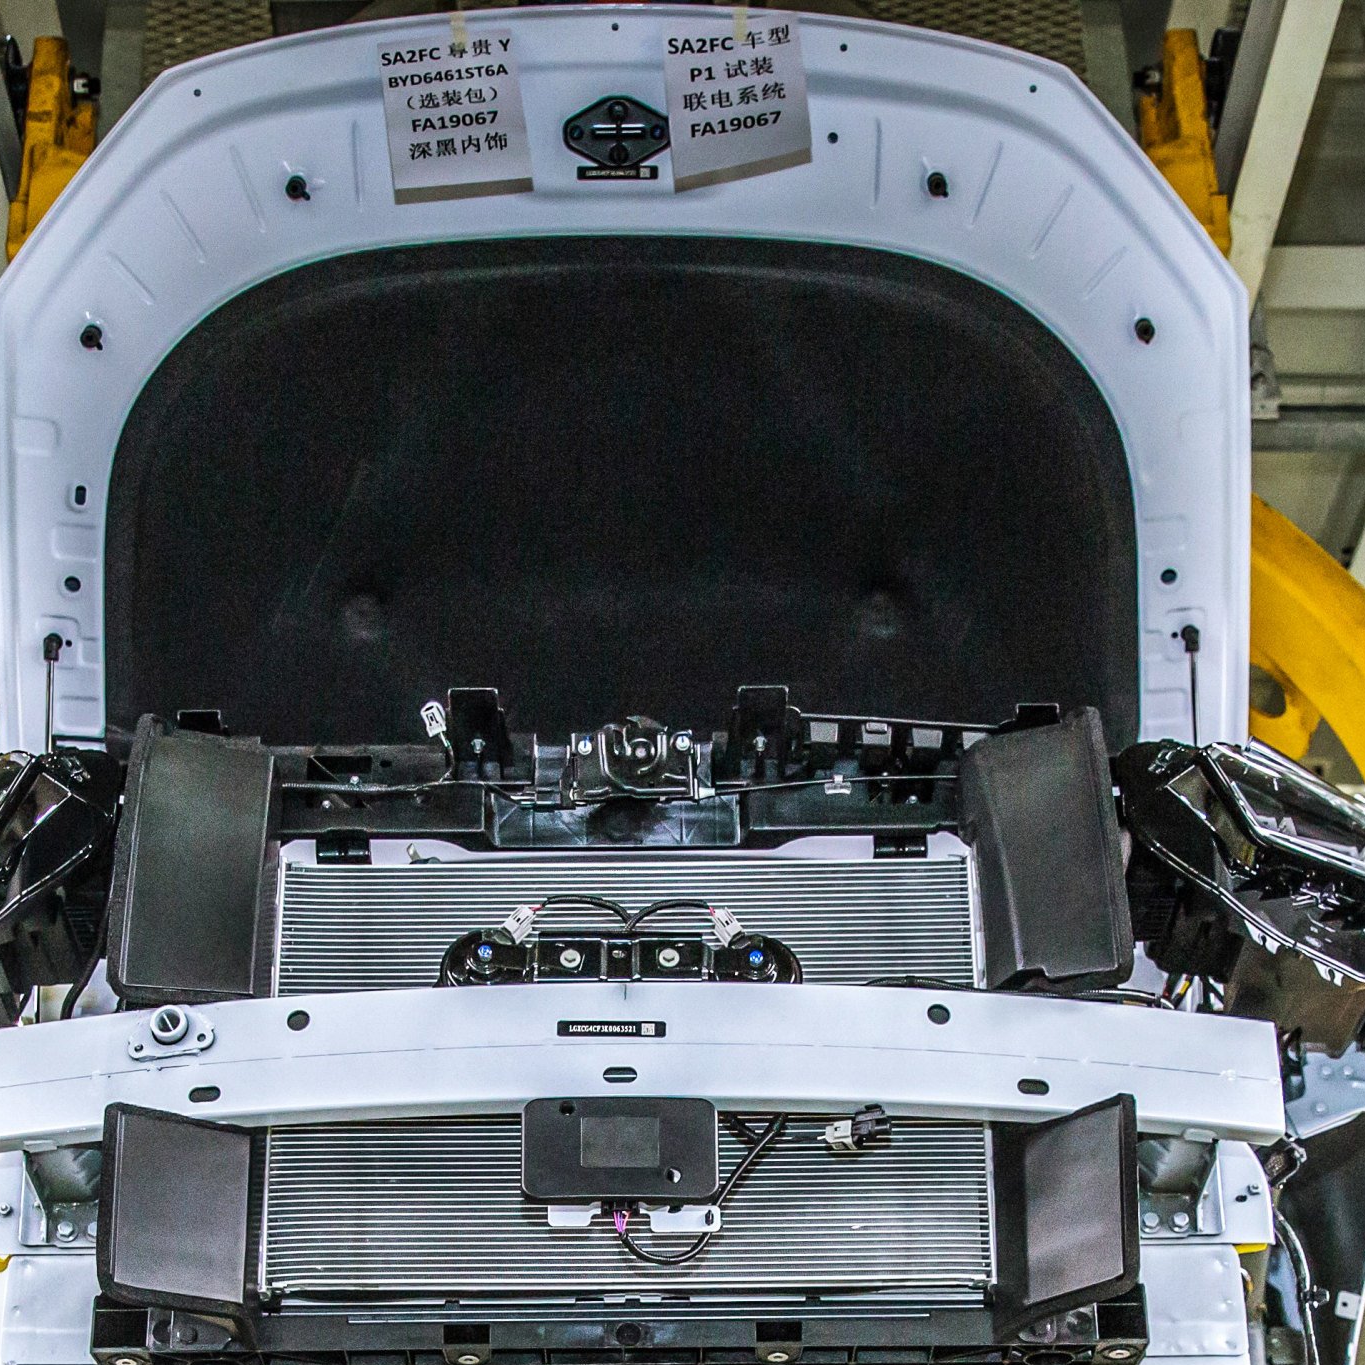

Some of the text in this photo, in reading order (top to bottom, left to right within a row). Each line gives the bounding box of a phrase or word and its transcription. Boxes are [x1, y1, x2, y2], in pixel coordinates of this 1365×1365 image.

[381, 47, 442, 67] SA2FC
[499, 38, 511, 52] Y
[667, 24, 791, 55] SA2FC 车型
[388, 63, 509, 89] BYD6461ST6A
[690, 56, 775, 82] P1 试装
[683, 81, 787, 113] 联电系统
[411, 110, 499, 133] FA19067
[690, 110, 783, 138] FA19067
[409, 131, 509, 161] 深黑内饰
